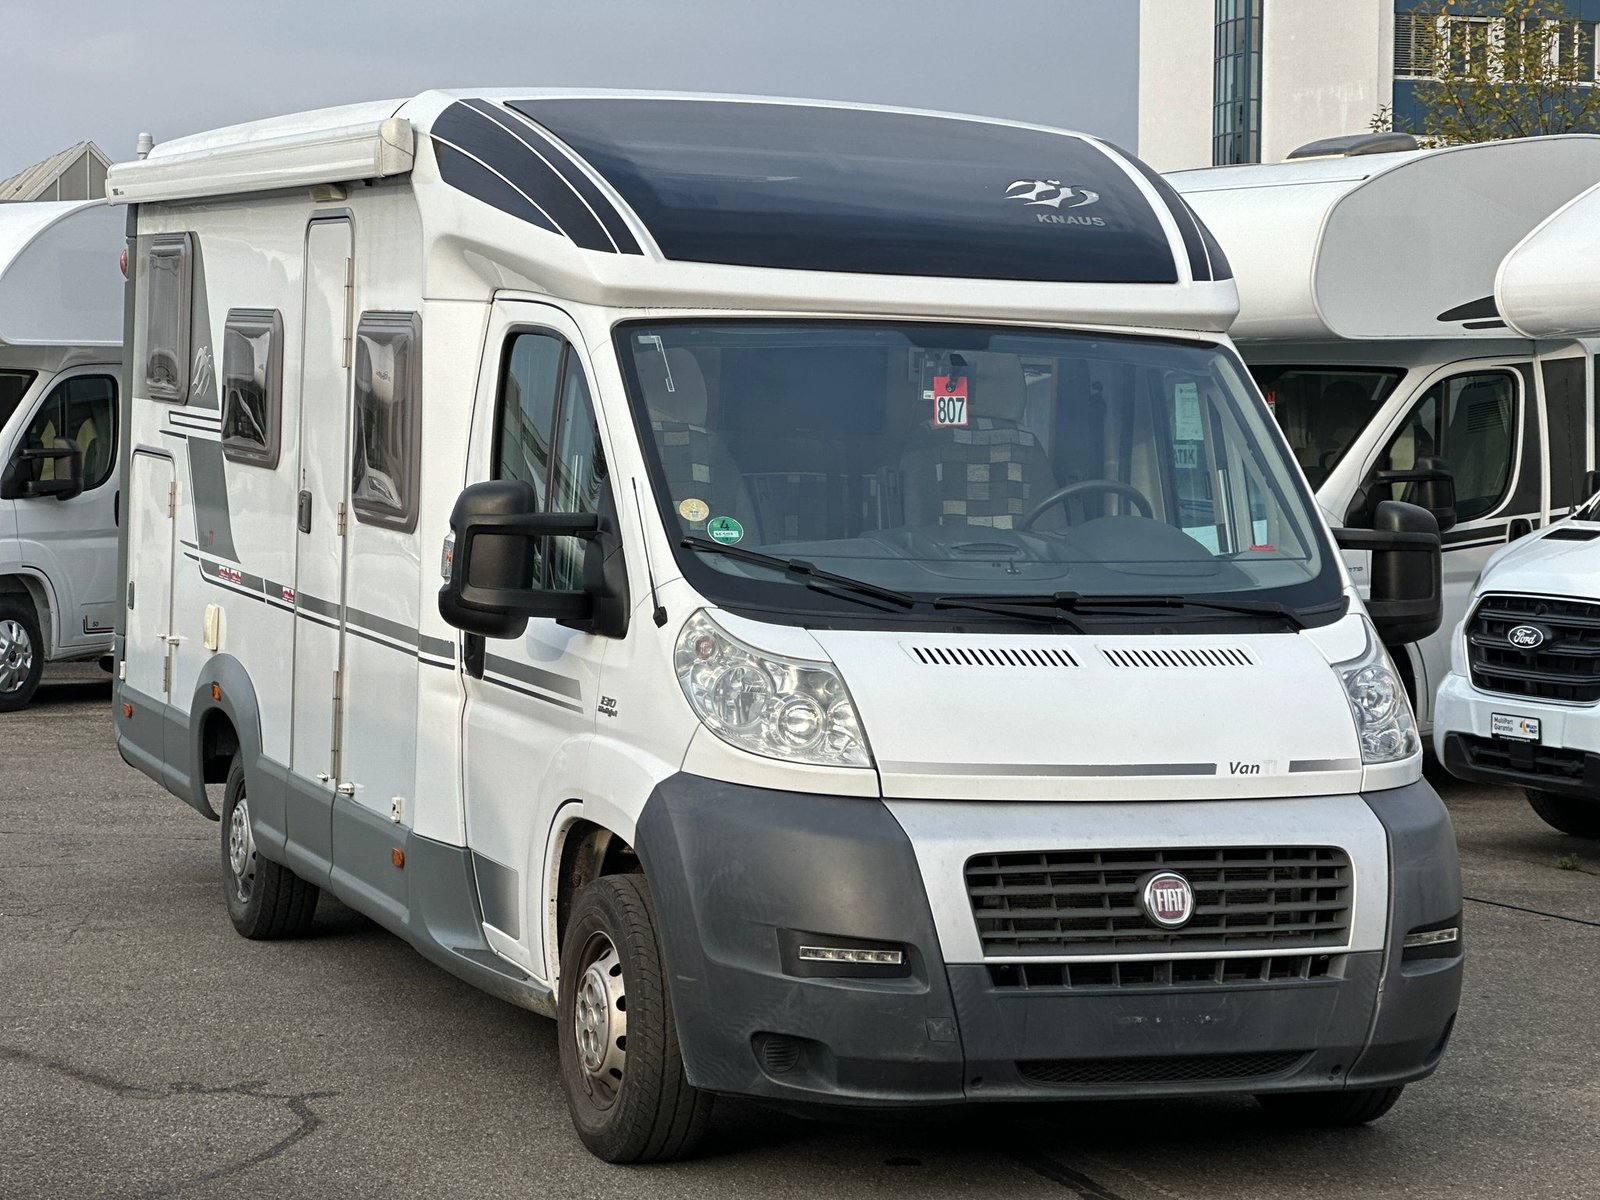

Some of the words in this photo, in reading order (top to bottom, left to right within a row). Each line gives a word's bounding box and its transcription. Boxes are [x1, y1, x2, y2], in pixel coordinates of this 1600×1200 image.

[1037, 214, 1106, 227] KNAUS
[938, 397, 965, 423] 807
[720, 519, 730, 531] 4
[1513, 629, 1537, 645] Ford
[1229, 761, 1260, 775] Van
[1156, 888, 1184, 912] FIAT
